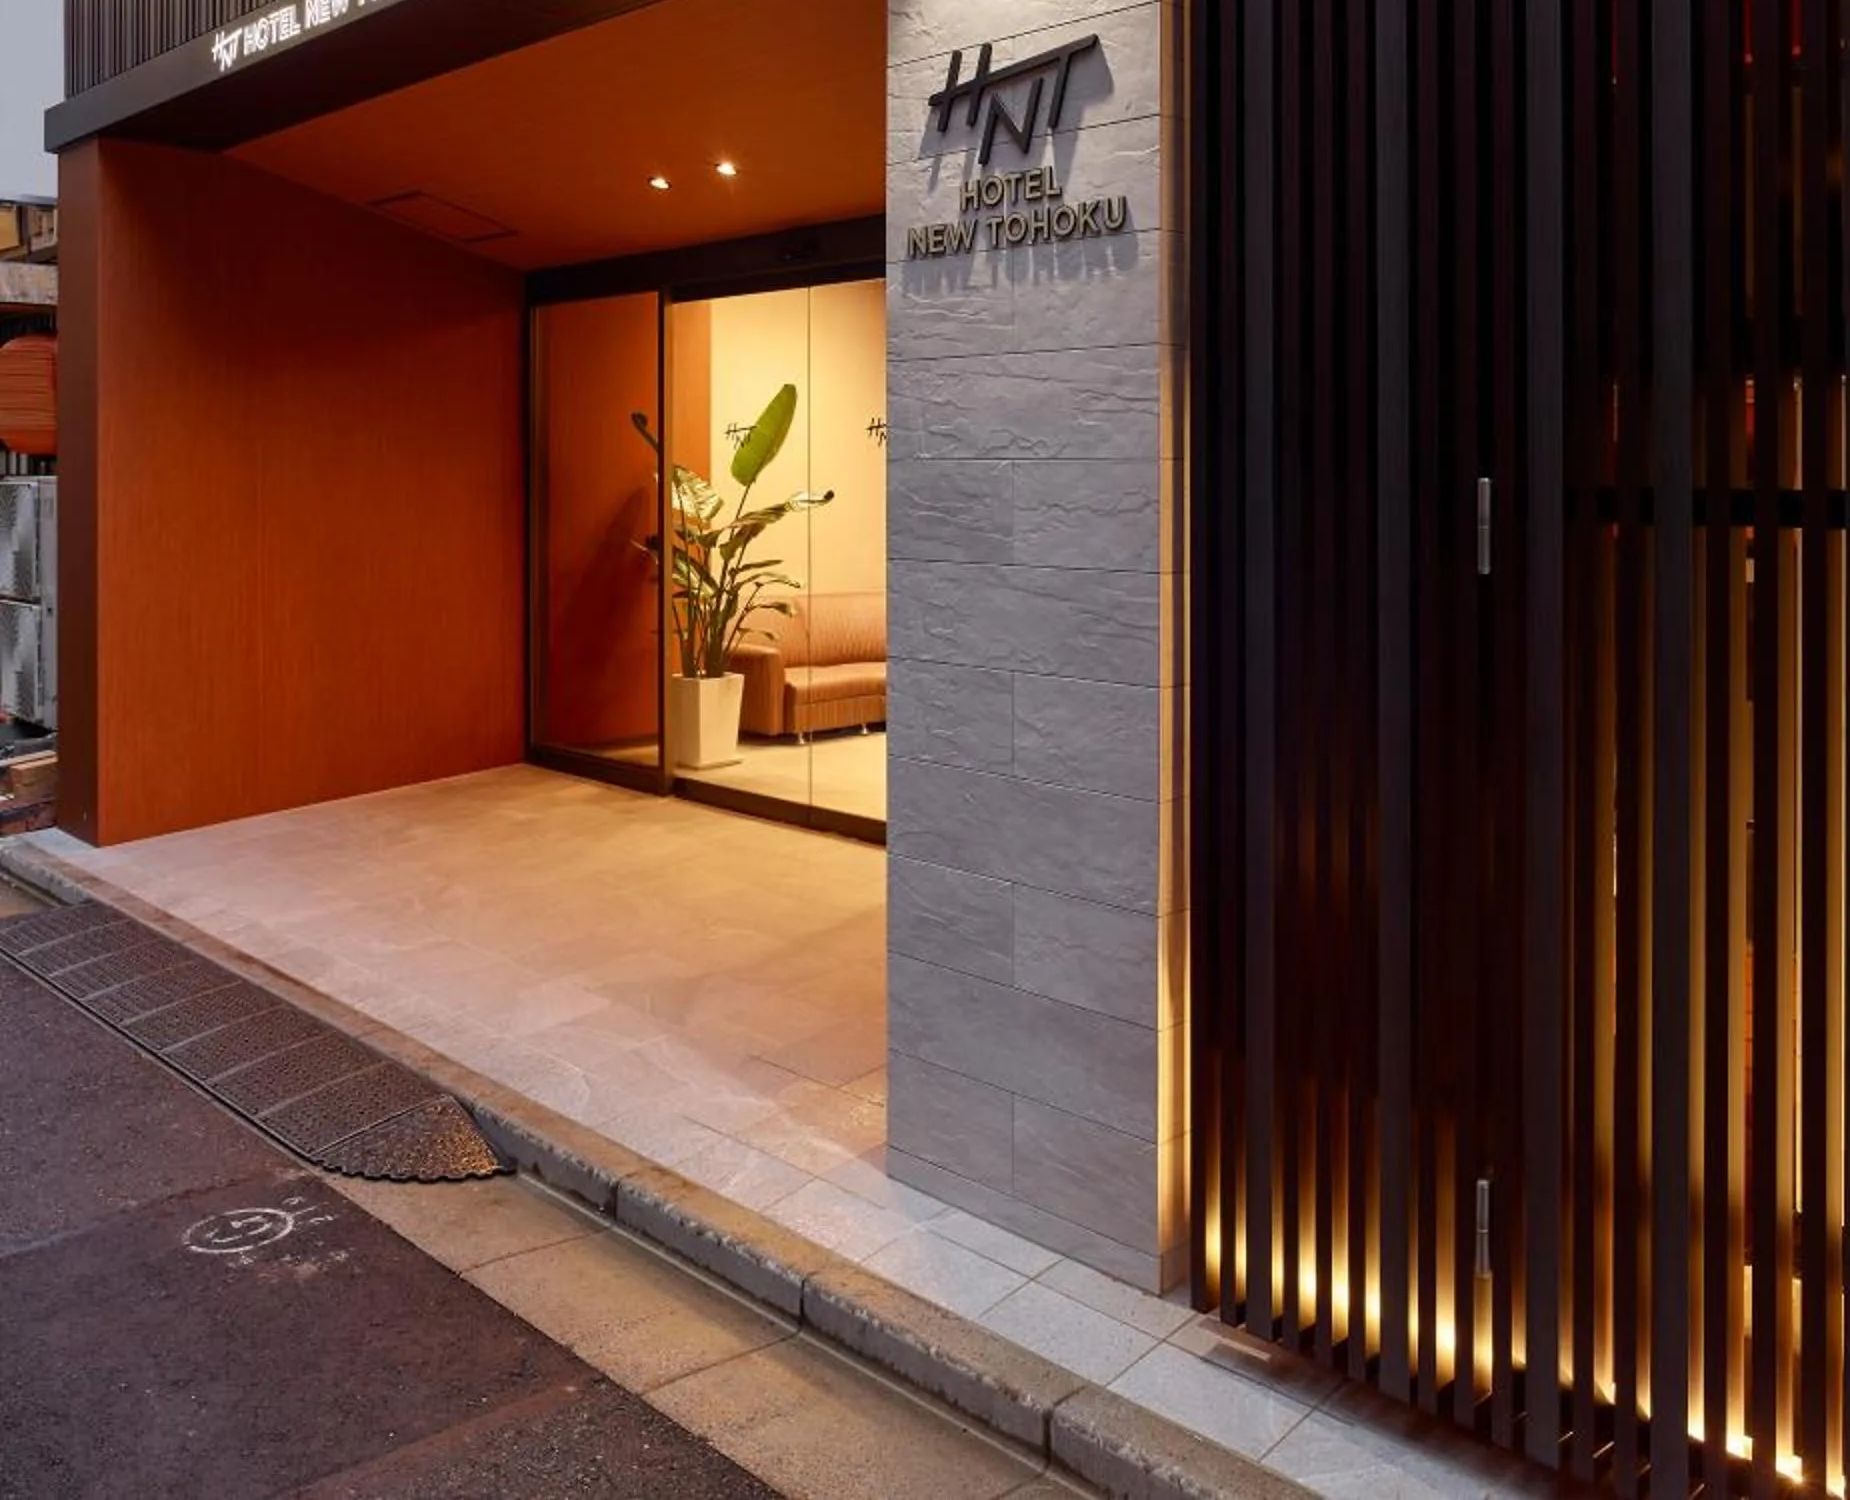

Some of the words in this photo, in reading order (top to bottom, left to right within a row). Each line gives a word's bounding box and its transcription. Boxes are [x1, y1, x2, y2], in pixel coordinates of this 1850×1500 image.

[243, 5, 301, 56] HOTEL
[960, 166, 1062, 213] HOTEL
[907, 219, 977, 260] NEW
[987, 196, 1127, 246] TOHOKU
